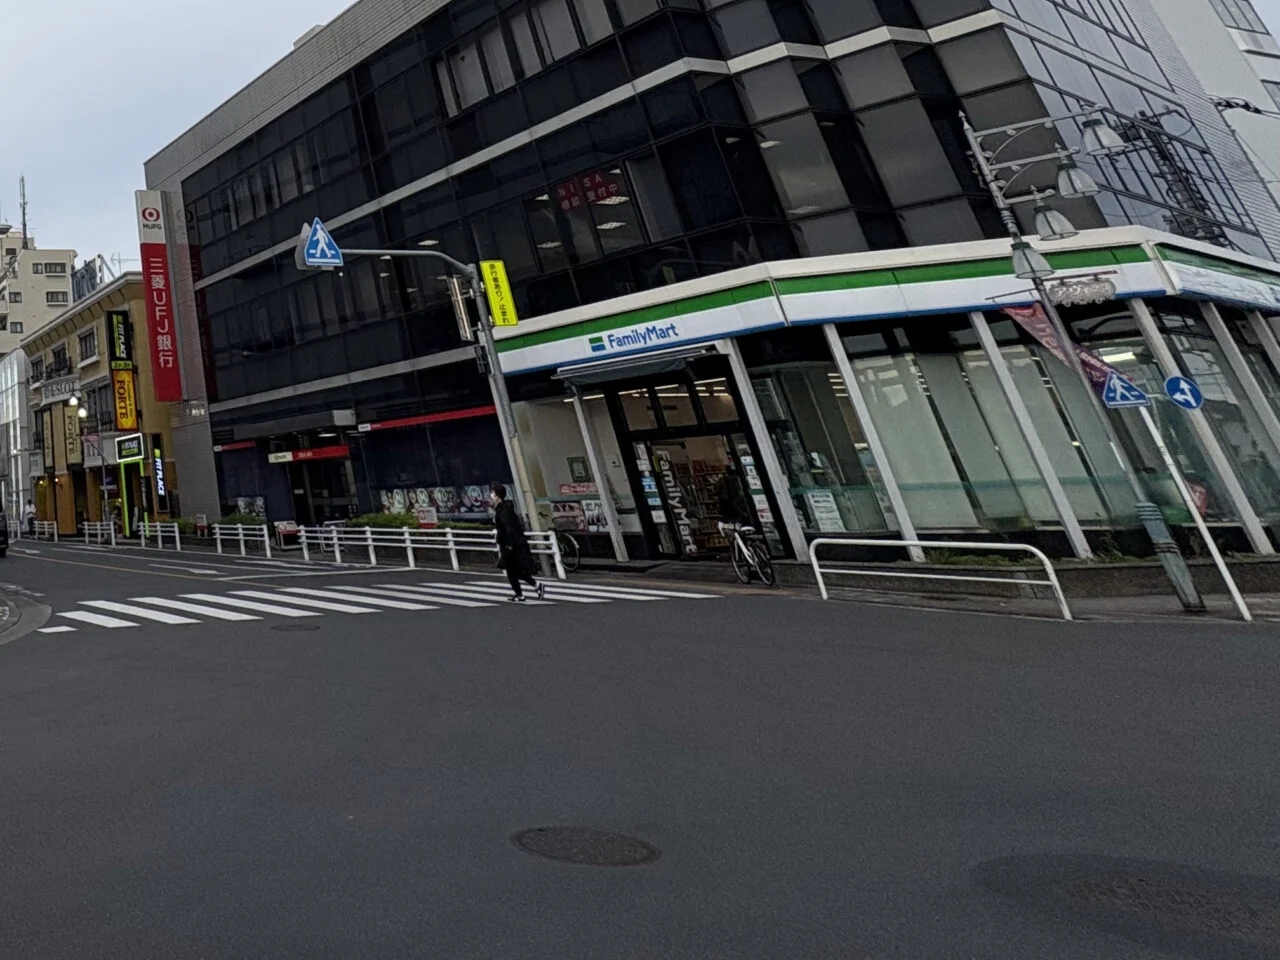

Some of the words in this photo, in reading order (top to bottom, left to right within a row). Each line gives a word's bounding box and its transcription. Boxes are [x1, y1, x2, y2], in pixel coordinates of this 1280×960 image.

[149, 257, 173, 368] 三菱UFJ銀行
[607, 323, 680, 348] FamilyMart
[655, 450, 698, 554] FamilyMart
